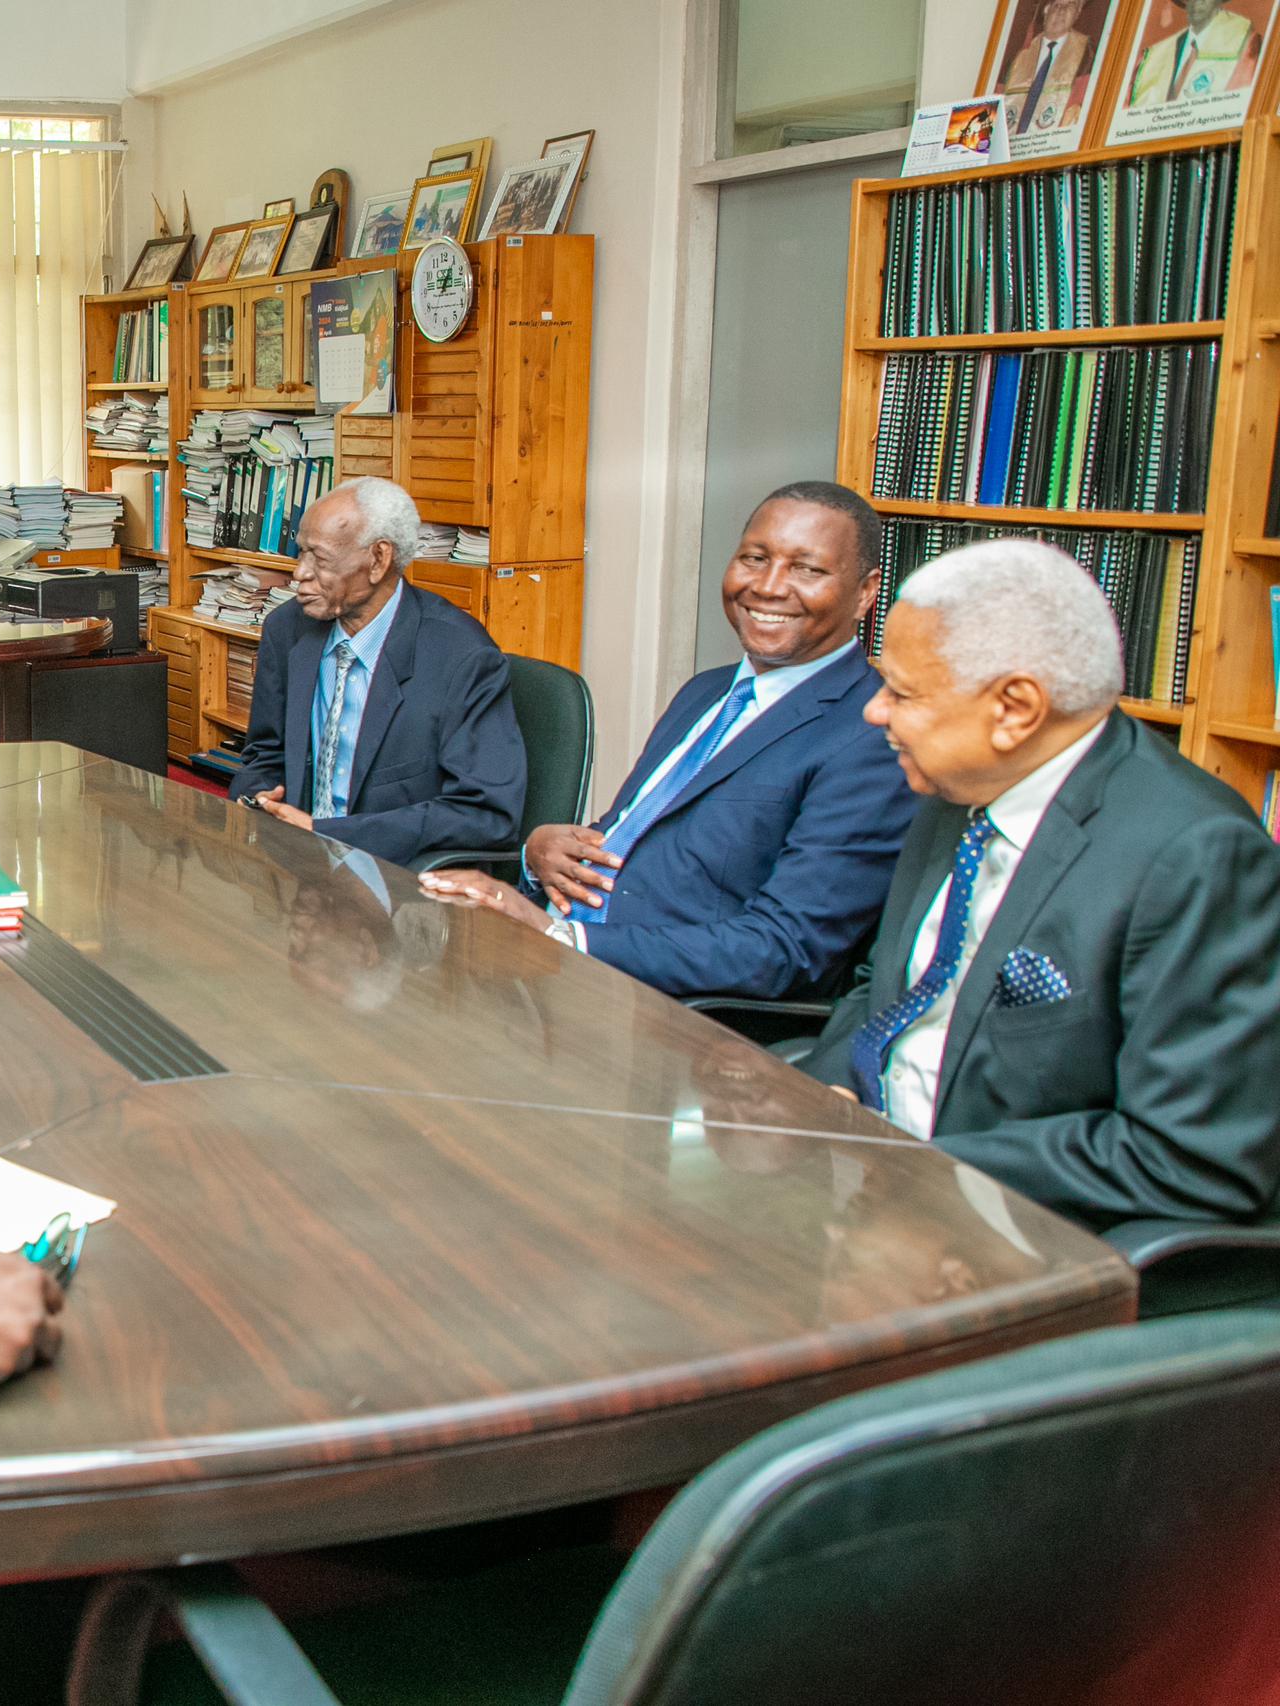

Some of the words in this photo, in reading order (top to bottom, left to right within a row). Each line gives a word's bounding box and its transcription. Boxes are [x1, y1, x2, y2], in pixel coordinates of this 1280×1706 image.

[1152, 110, 1192, 123] Chancellor
[1146, 120, 1184, 133] University
[1186, 118, 1197, 127] of
[1197, 112, 1242, 126] Agriculture
[440, 251, 448, 263] 12
[432, 258, 439, 269] 11
[458, 265, 463, 276] 2
[426, 271, 433, 282] 10
[423, 288, 428, 298] 9
[317, 303, 332, 313] NMB
[426, 302, 431, 313] 8
[433, 312, 438, 324] 7
[452, 310, 457, 321] 5
[443, 317, 448, 328] 6
